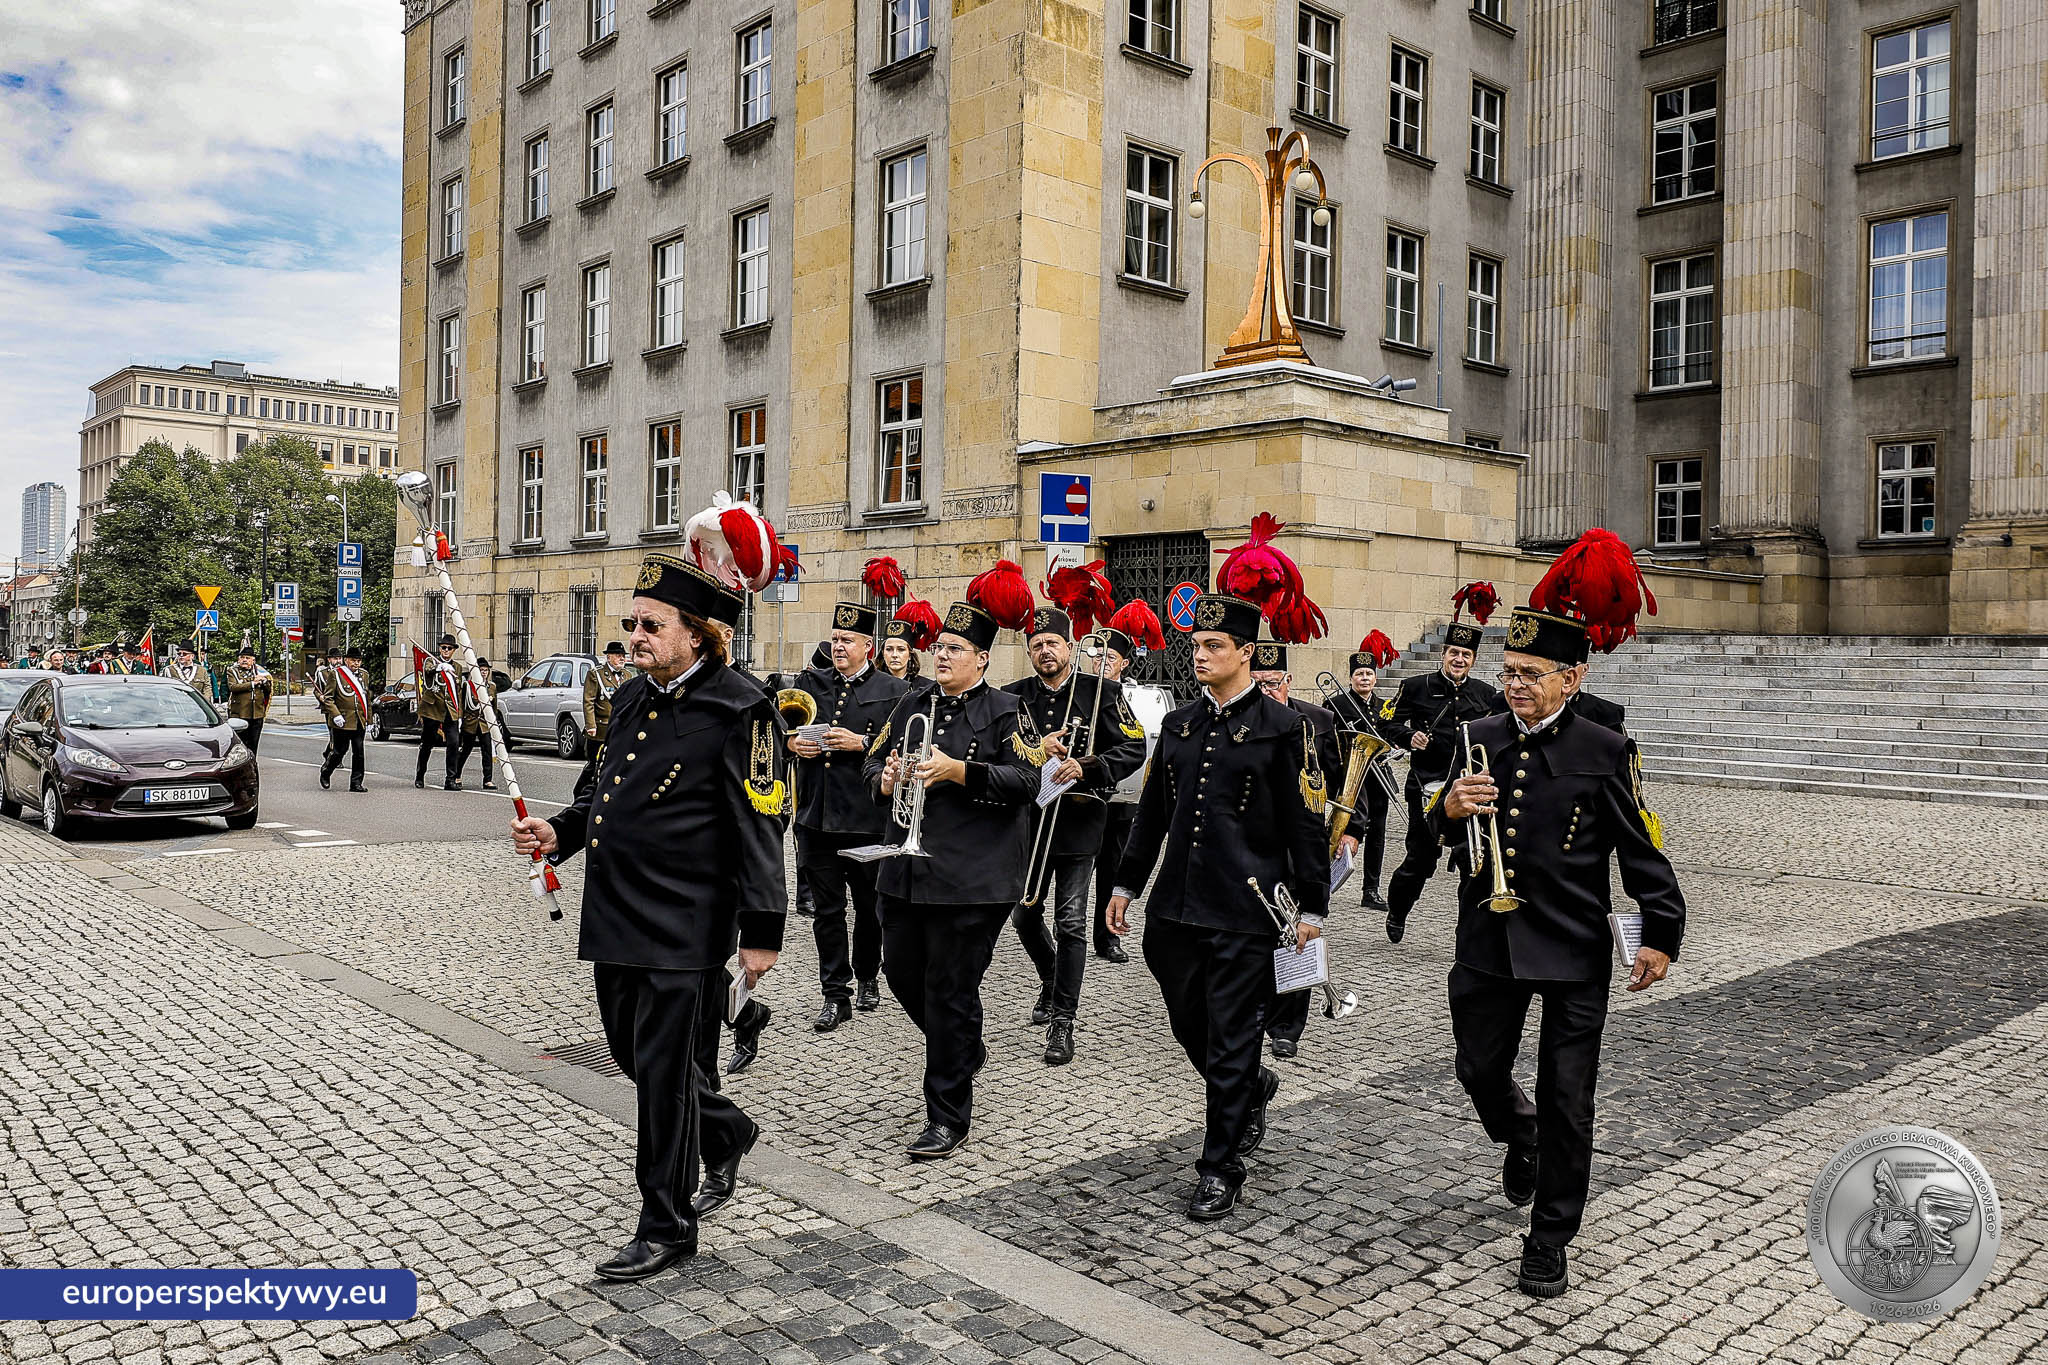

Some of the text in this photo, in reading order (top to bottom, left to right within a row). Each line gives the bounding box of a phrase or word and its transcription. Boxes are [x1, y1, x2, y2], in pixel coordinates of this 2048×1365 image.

[343, 545, 357, 564] P
[338, 568, 361, 576] Koniec
[281, 586, 291, 599] P
[343, 580, 357, 598] P
[152, 791, 169, 801] SK
[172, 788, 208, 800] 8810V
